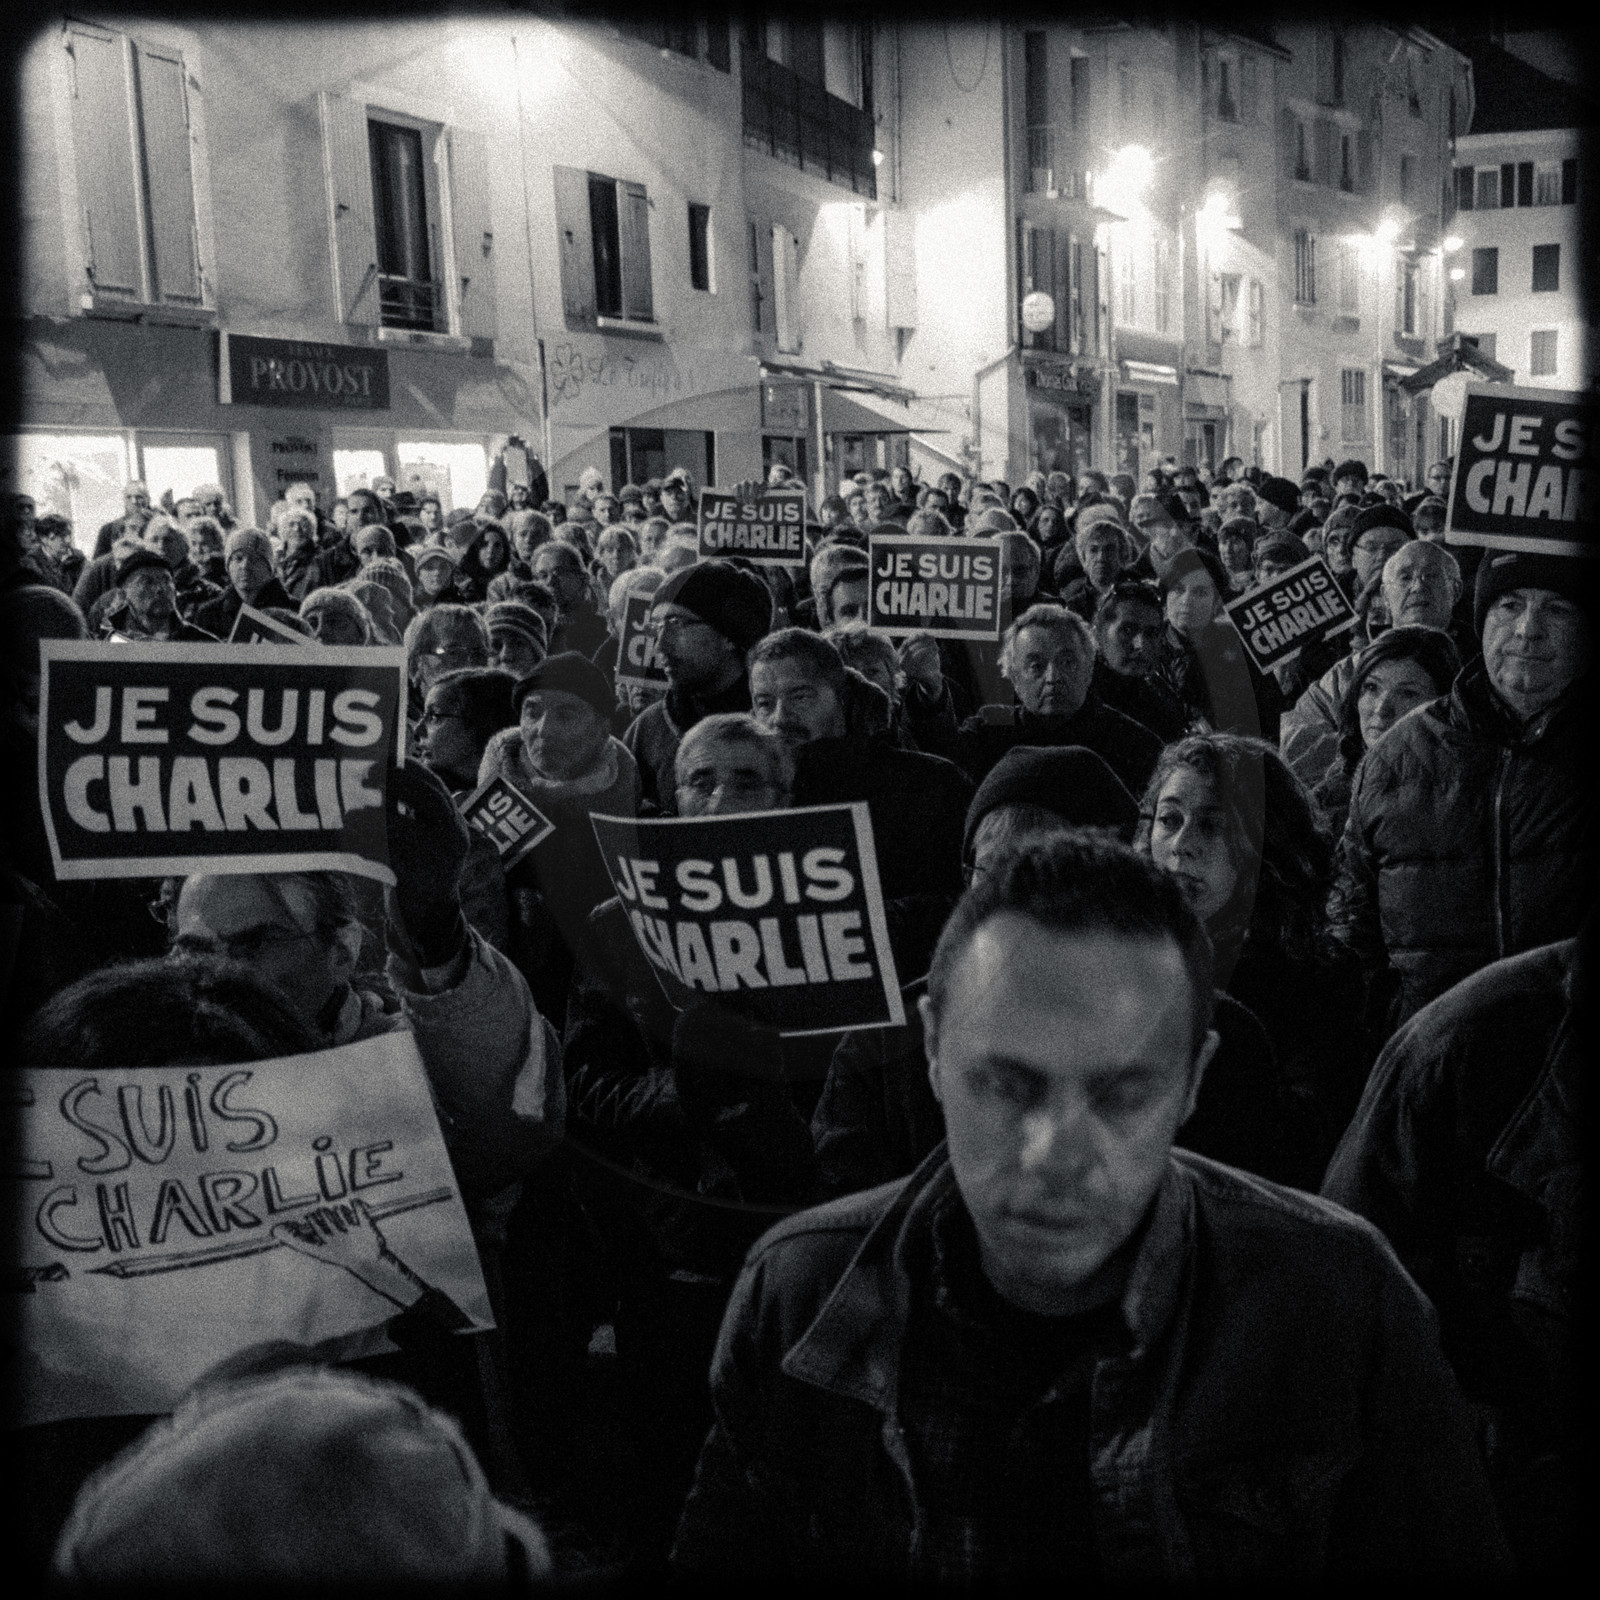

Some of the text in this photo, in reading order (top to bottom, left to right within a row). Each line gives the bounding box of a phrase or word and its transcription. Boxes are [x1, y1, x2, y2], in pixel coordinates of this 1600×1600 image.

[249, 356, 374, 396] PROVOST
[1472, 412, 1543, 457] JE
[703, 521, 801, 551] CHARLIE
[705, 501, 800, 522] JE SUIS
[876, 552, 994, 581] JE SUIS
[876, 580, 994, 620] CHARLIE
[1242, 570, 1328, 631] JE SUIS
[1250, 588, 1347, 655] CHARLIE
[63, 685, 384, 748] JE SUIS
[63, 753, 384, 833] CHARLIE
[616, 846, 856, 913] JE SUIS
[630, 909, 875, 993] CHARLIE
